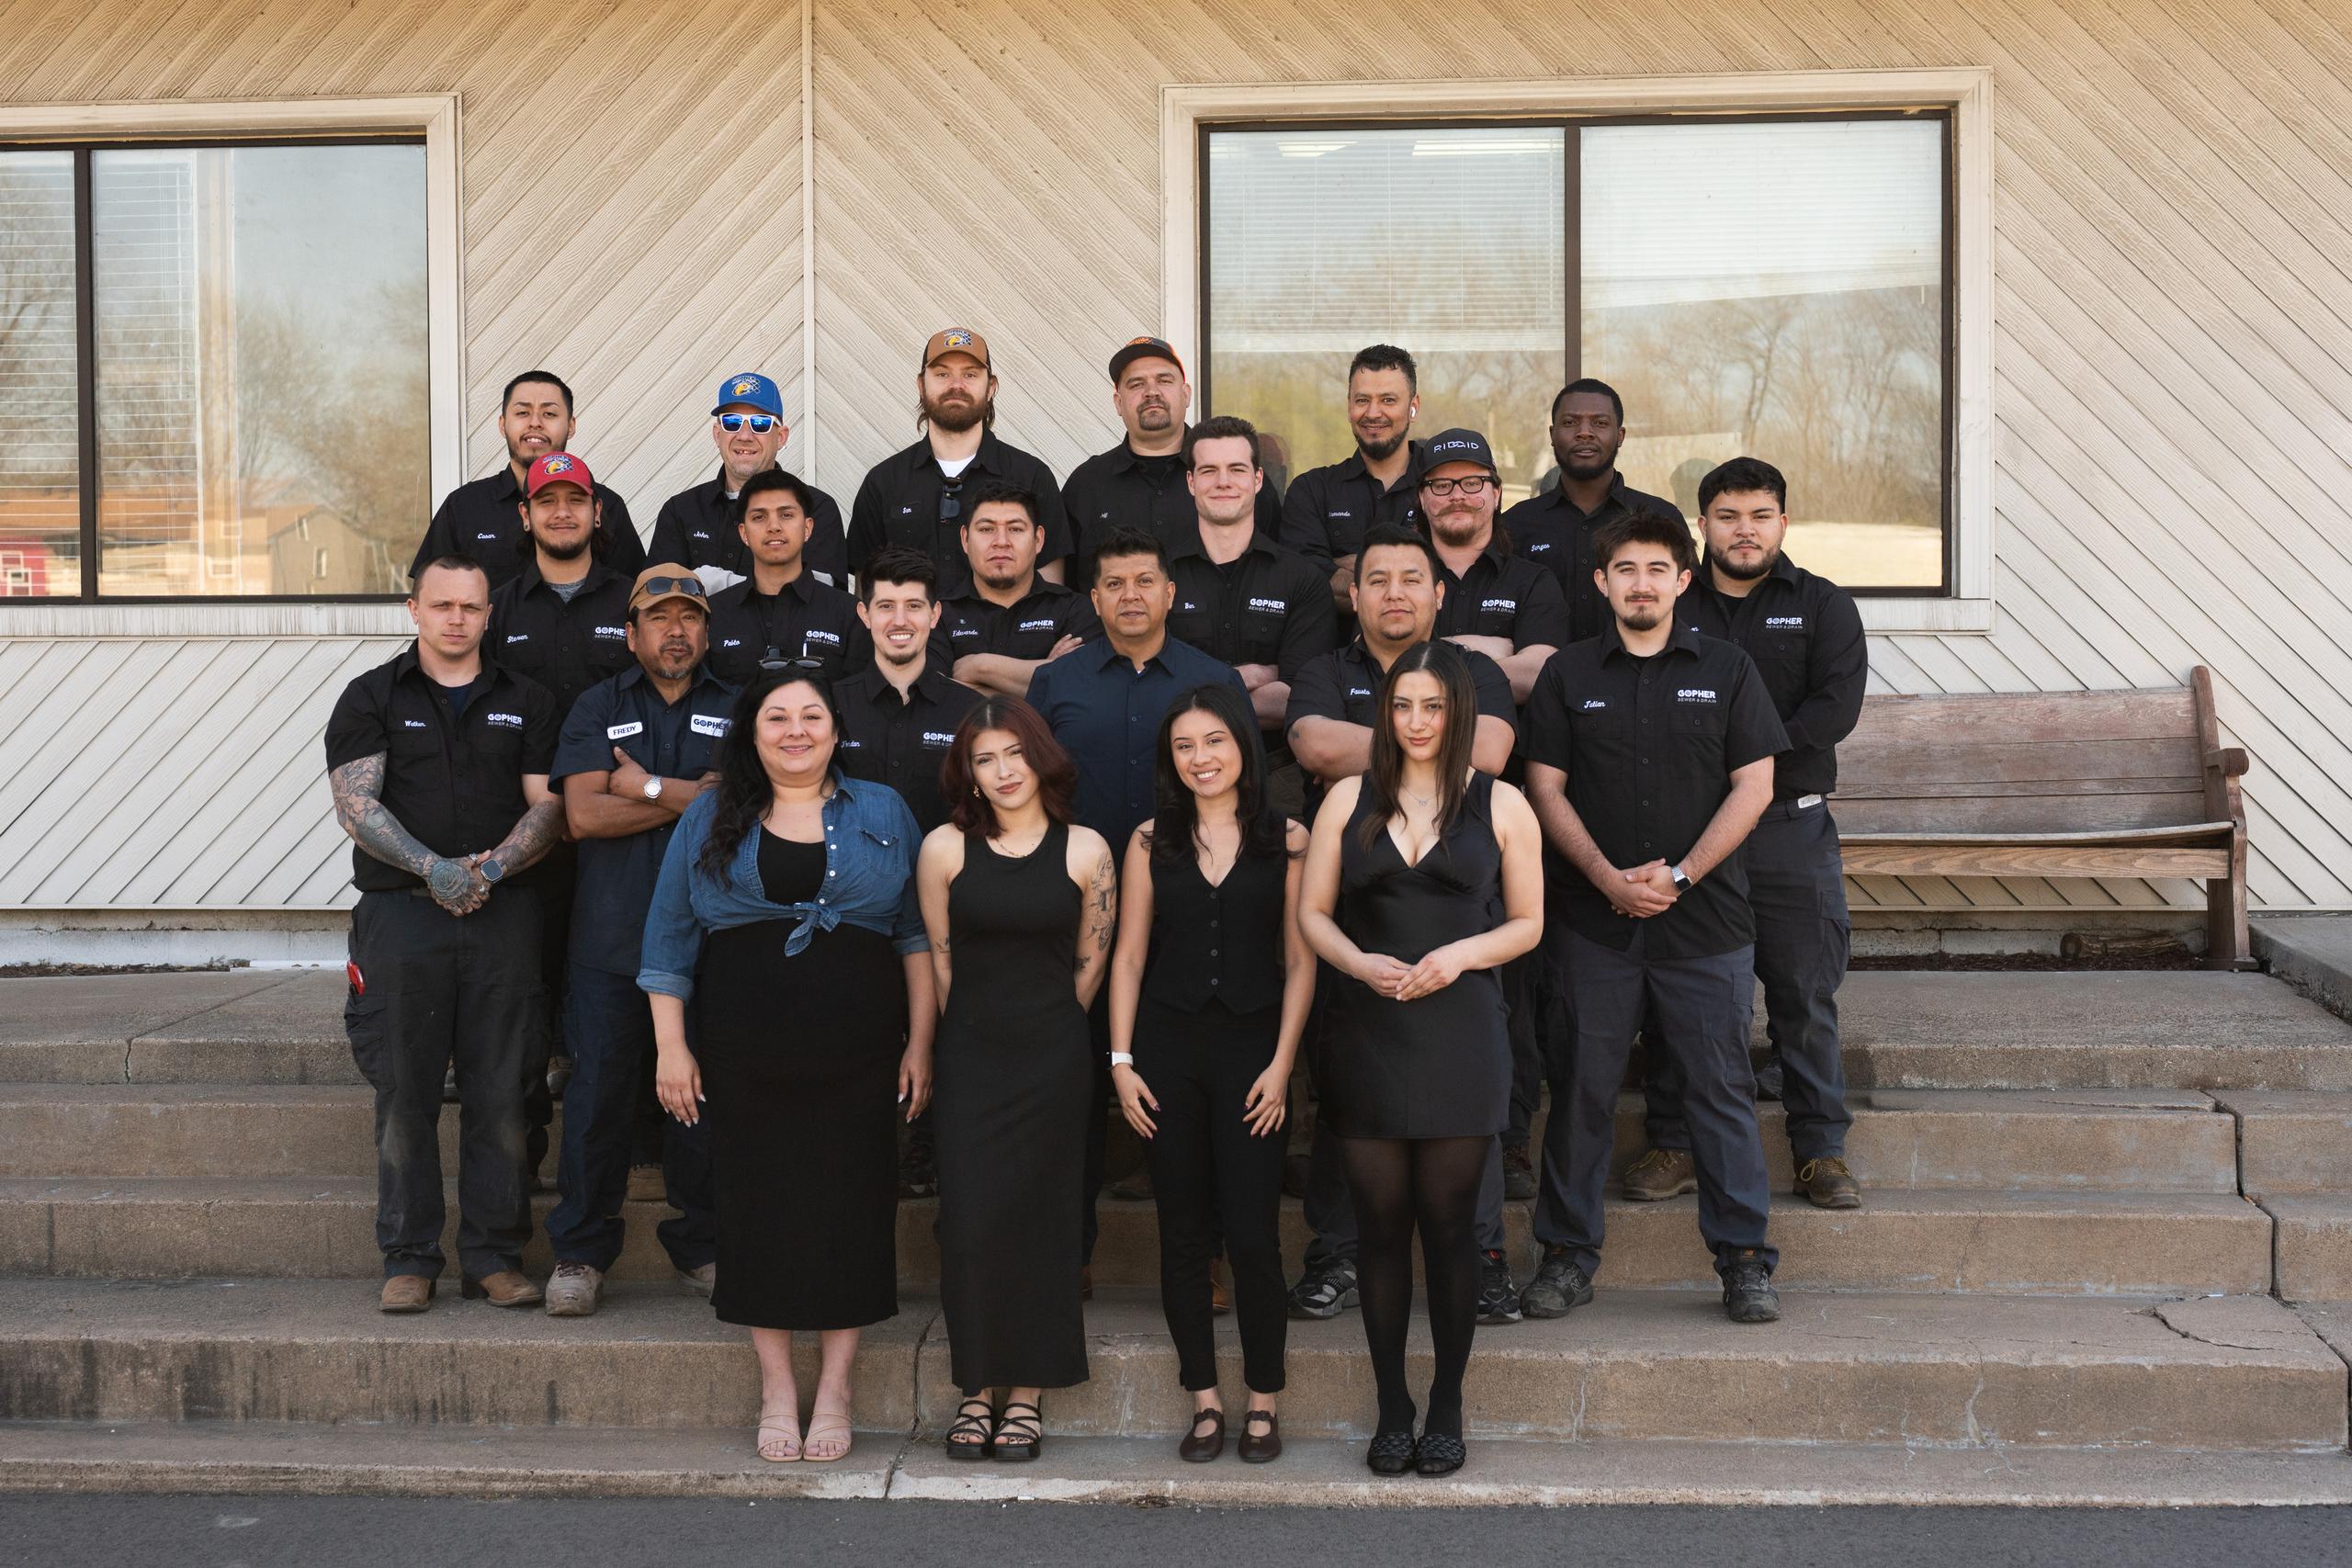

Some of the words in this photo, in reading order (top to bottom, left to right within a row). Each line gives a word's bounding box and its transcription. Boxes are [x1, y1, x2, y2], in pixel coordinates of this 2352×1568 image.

[1250, 598, 1284, 610] GOPHER
[1481, 600, 1516, 609] GOPHER
[1020, 620, 1054, 628] GOPHER
[594, 626, 627, 637] GOPHE
[806, 630, 840, 643] GOPHER
[1677, 689, 1716, 699] GOPHER
[488, 714, 523, 726] GOPHER
[694, 718, 726, 729] GOPHE
[613, 726, 637, 736] FREDY
[922, 732, 956, 742] GOPHE
